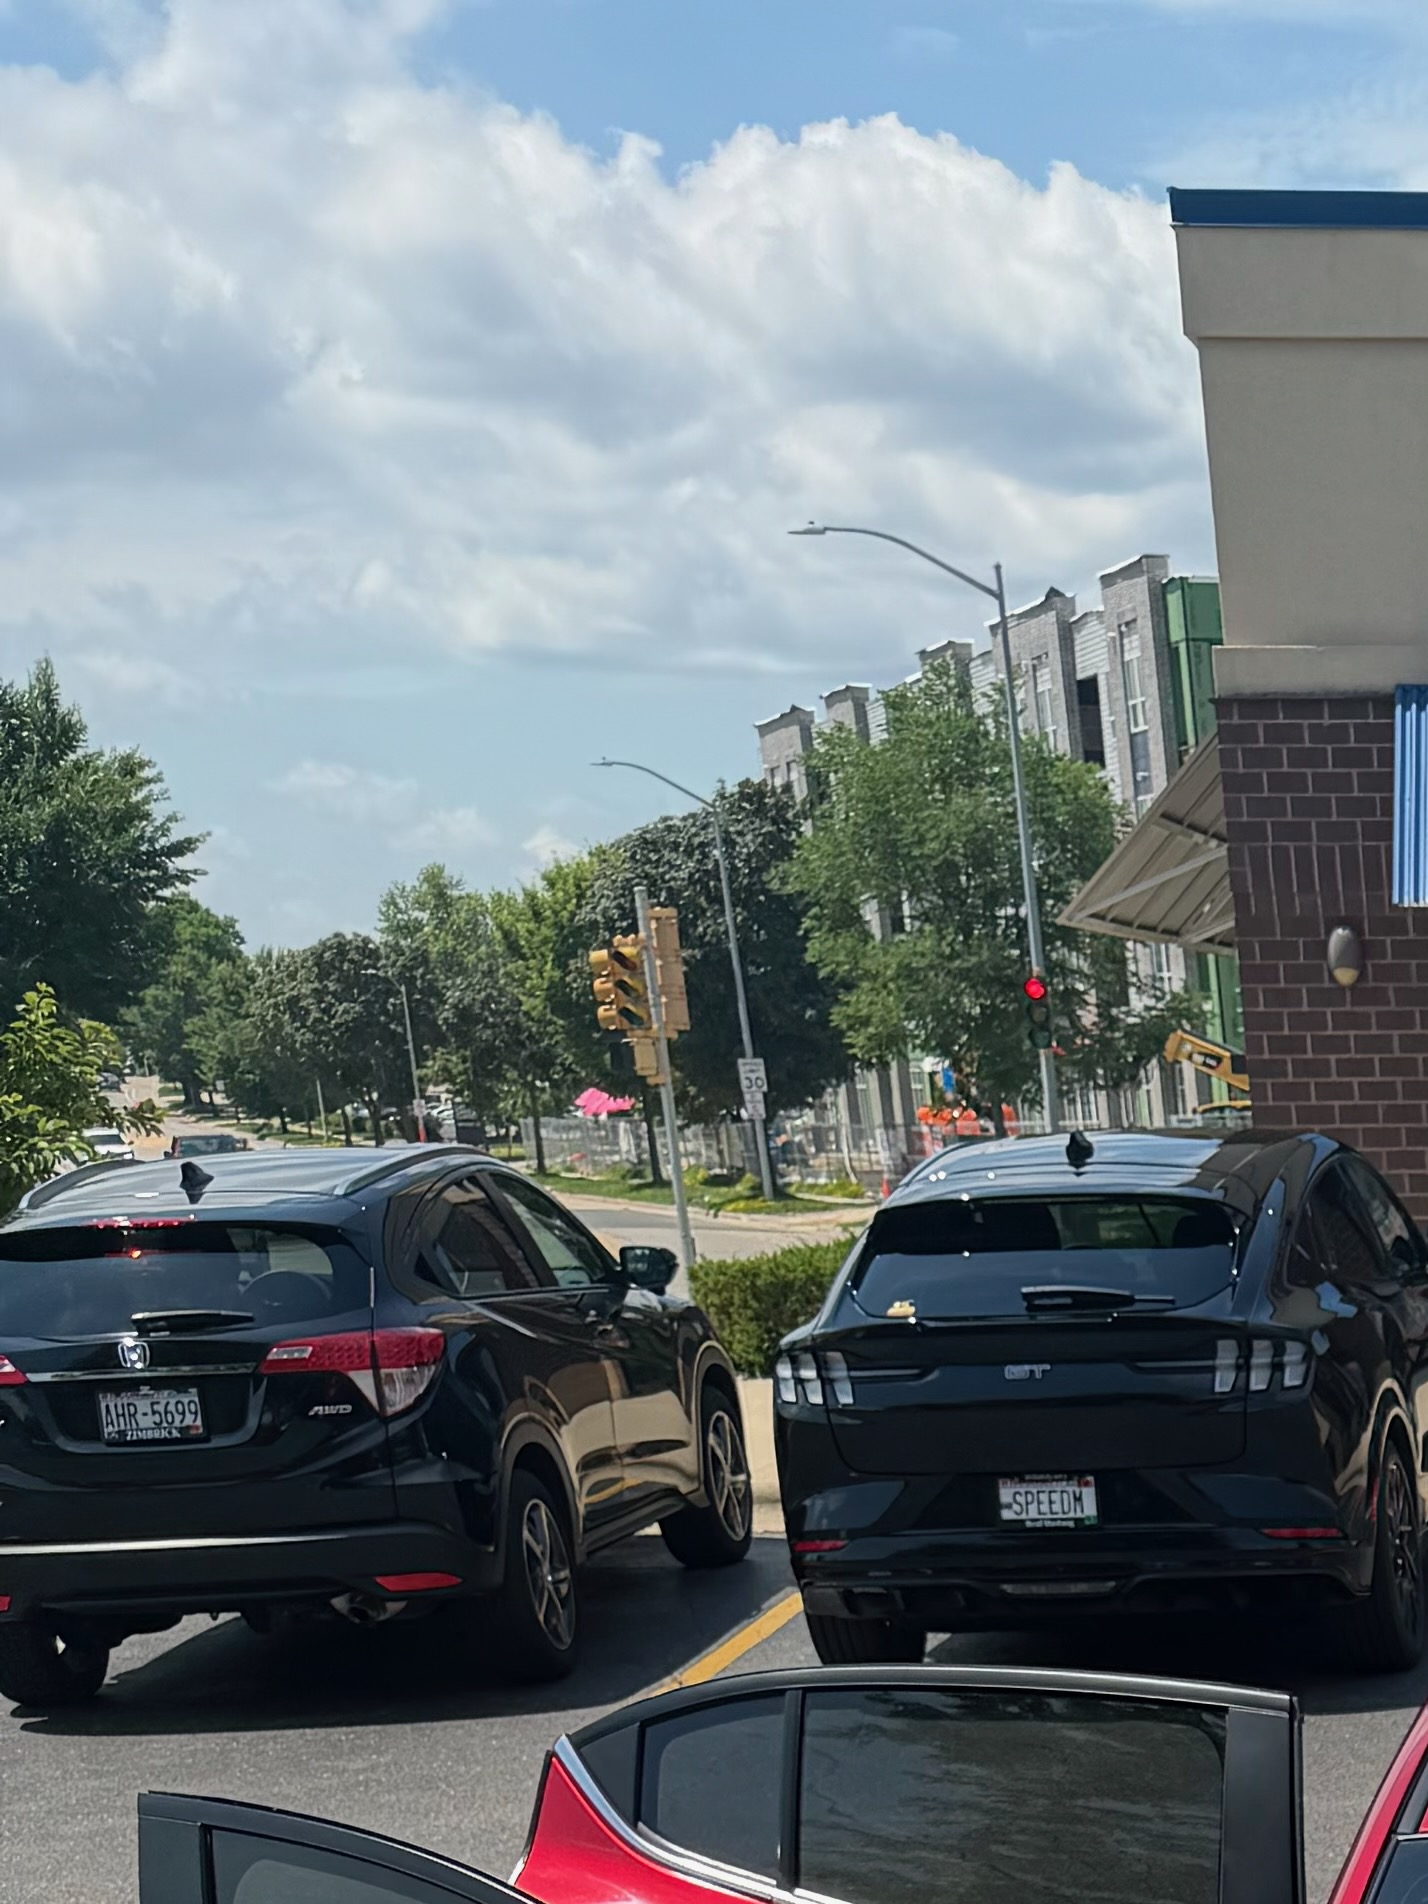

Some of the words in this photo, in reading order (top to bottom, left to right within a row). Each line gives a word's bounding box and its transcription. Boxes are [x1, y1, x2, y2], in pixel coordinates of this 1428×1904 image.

[1004, 1363, 1052, 1380] GT
[105, 1400, 199, 1430] AHR-5699
[308, 1404, 353, 1416] AWD
[1012, 1489, 1085, 1517] SPEEDM
